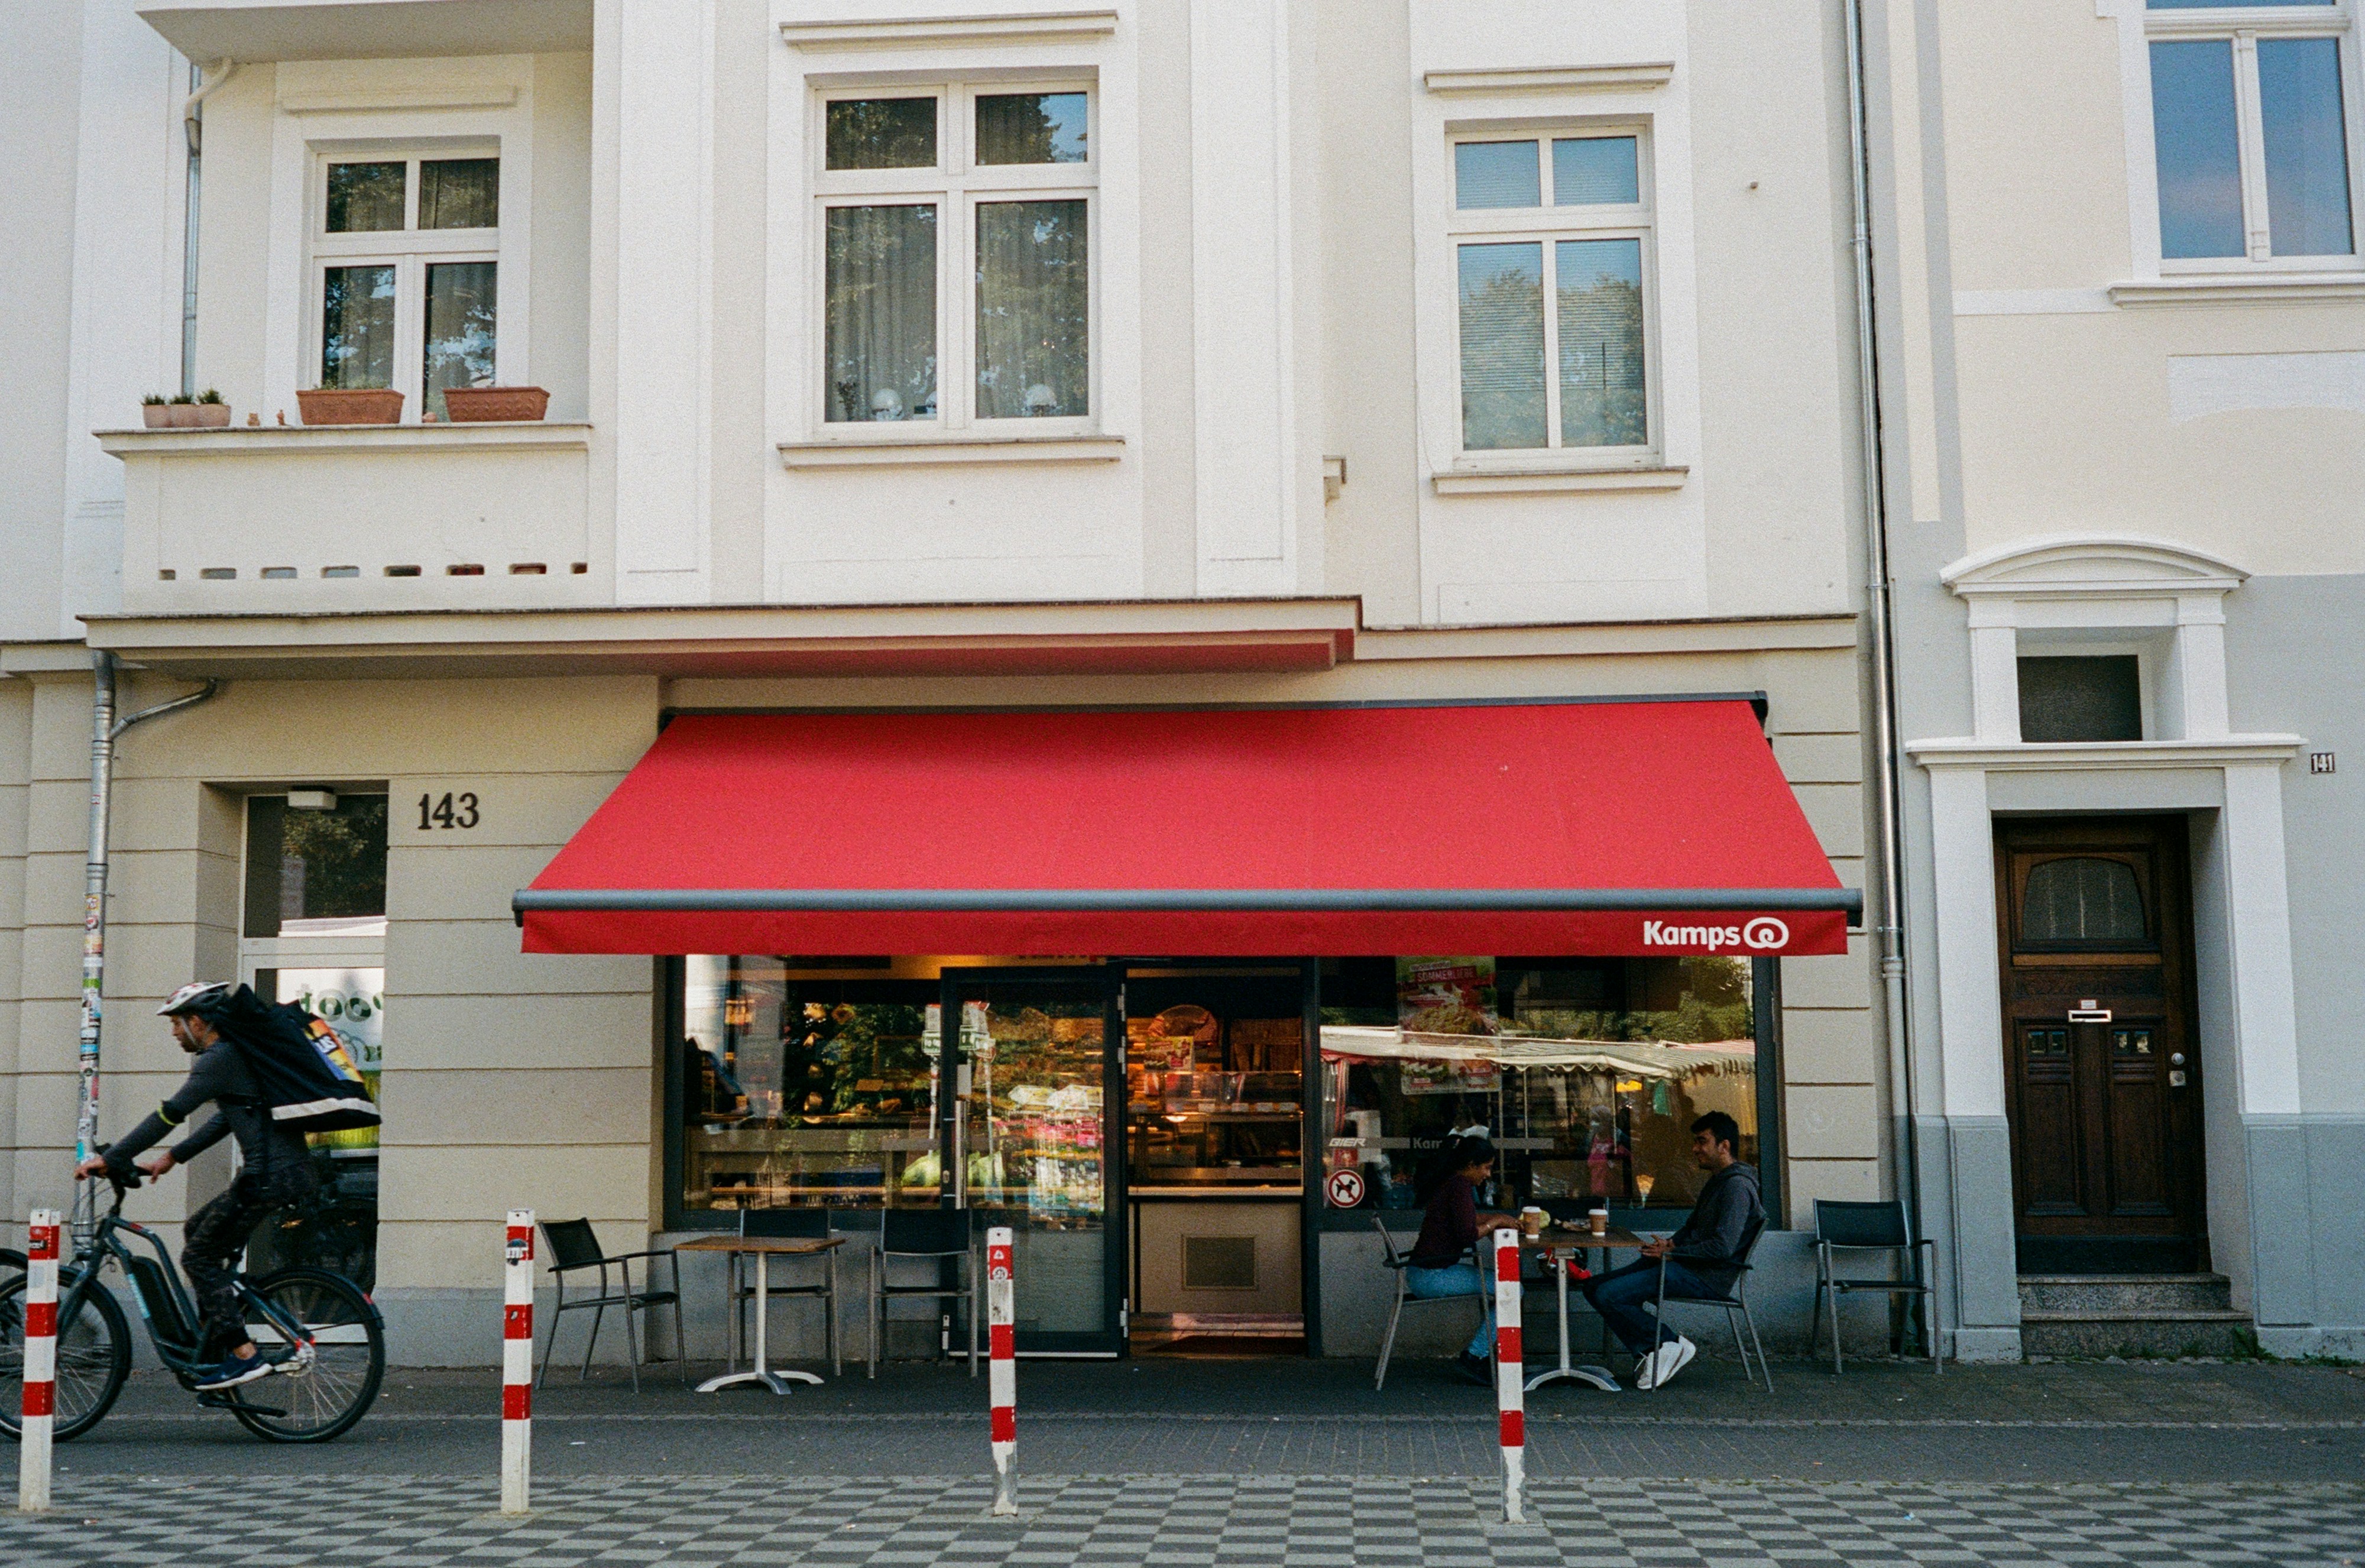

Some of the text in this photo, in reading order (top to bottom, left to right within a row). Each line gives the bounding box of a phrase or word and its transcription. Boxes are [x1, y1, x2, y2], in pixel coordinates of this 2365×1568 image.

[2312, 754, 2333, 772] 141
[417, 792, 479, 830] 143
[1644, 920, 1741, 951] Kamps
